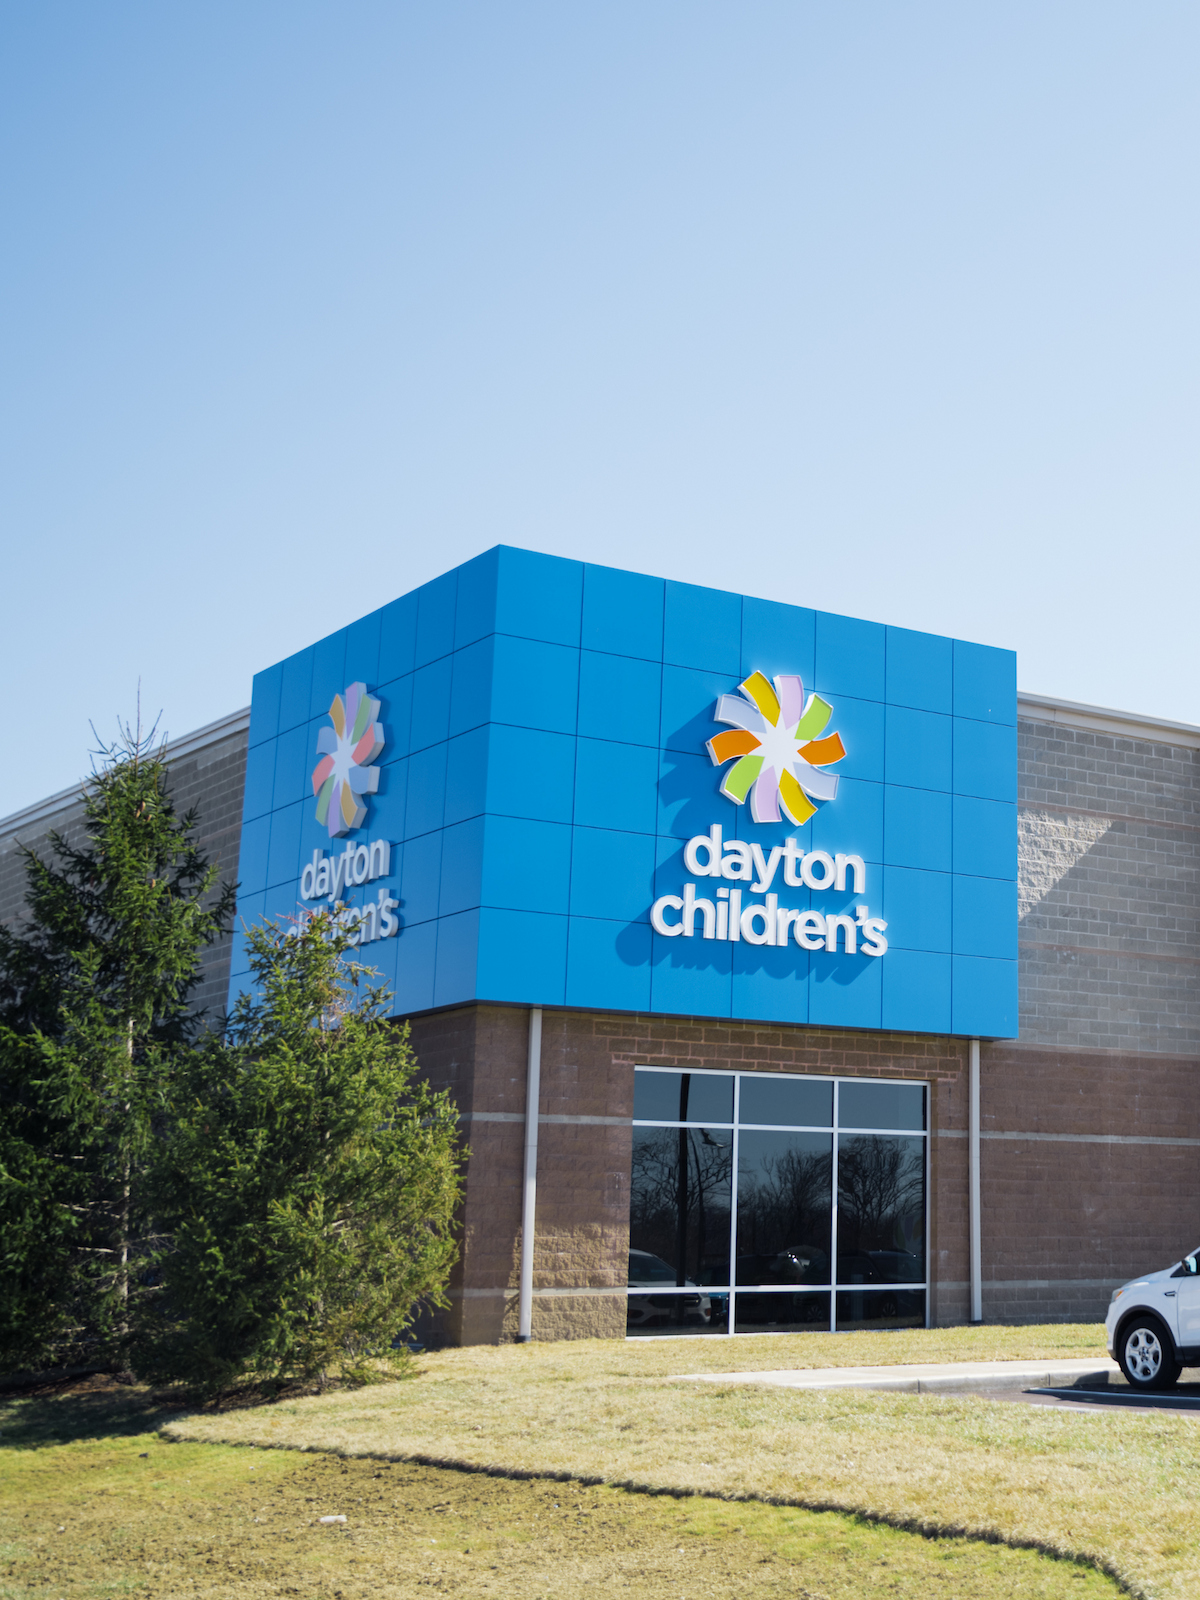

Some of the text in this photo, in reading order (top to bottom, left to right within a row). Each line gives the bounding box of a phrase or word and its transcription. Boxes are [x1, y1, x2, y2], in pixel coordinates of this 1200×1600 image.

[301, 839, 390, 902] dayton
[684, 824, 865, 893] dayton
[651, 883, 888, 957] children's
